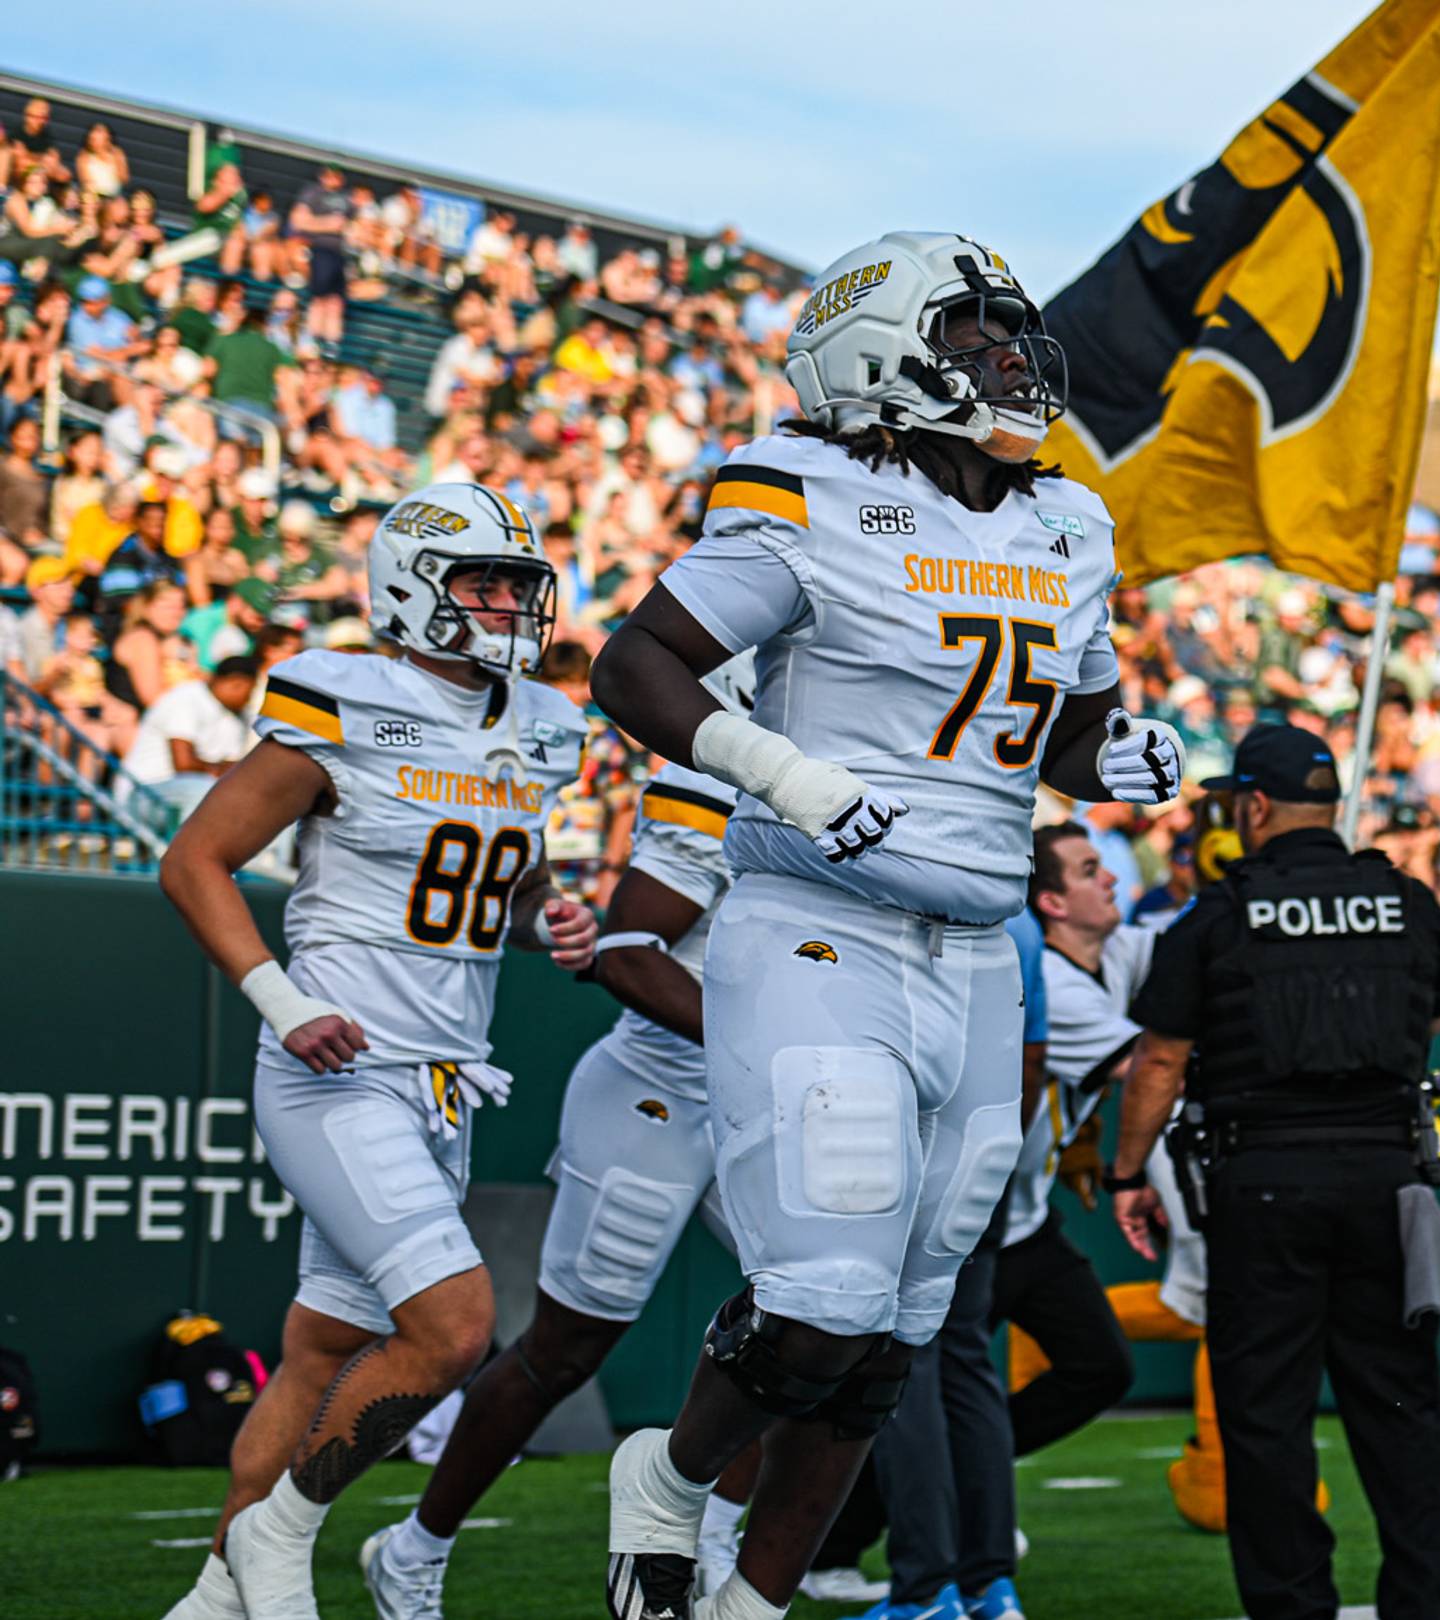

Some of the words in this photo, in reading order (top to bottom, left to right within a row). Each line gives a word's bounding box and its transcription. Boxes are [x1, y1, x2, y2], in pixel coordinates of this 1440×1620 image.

[815, 291, 852, 330] MISS
[859, 505, 915, 534] SBC
[904, 554, 1026, 602] SOUTHERN
[1028, 565, 1070, 608] MISS
[926, 612, 1060, 769] 75
[374, 719, 422, 747] SBC
[395, 765, 508, 809] SOUTHERN
[405, 818, 530, 952] 88
[1248, 895, 1405, 936] POLICE
[0, 1092, 265, 1163] MERIC
